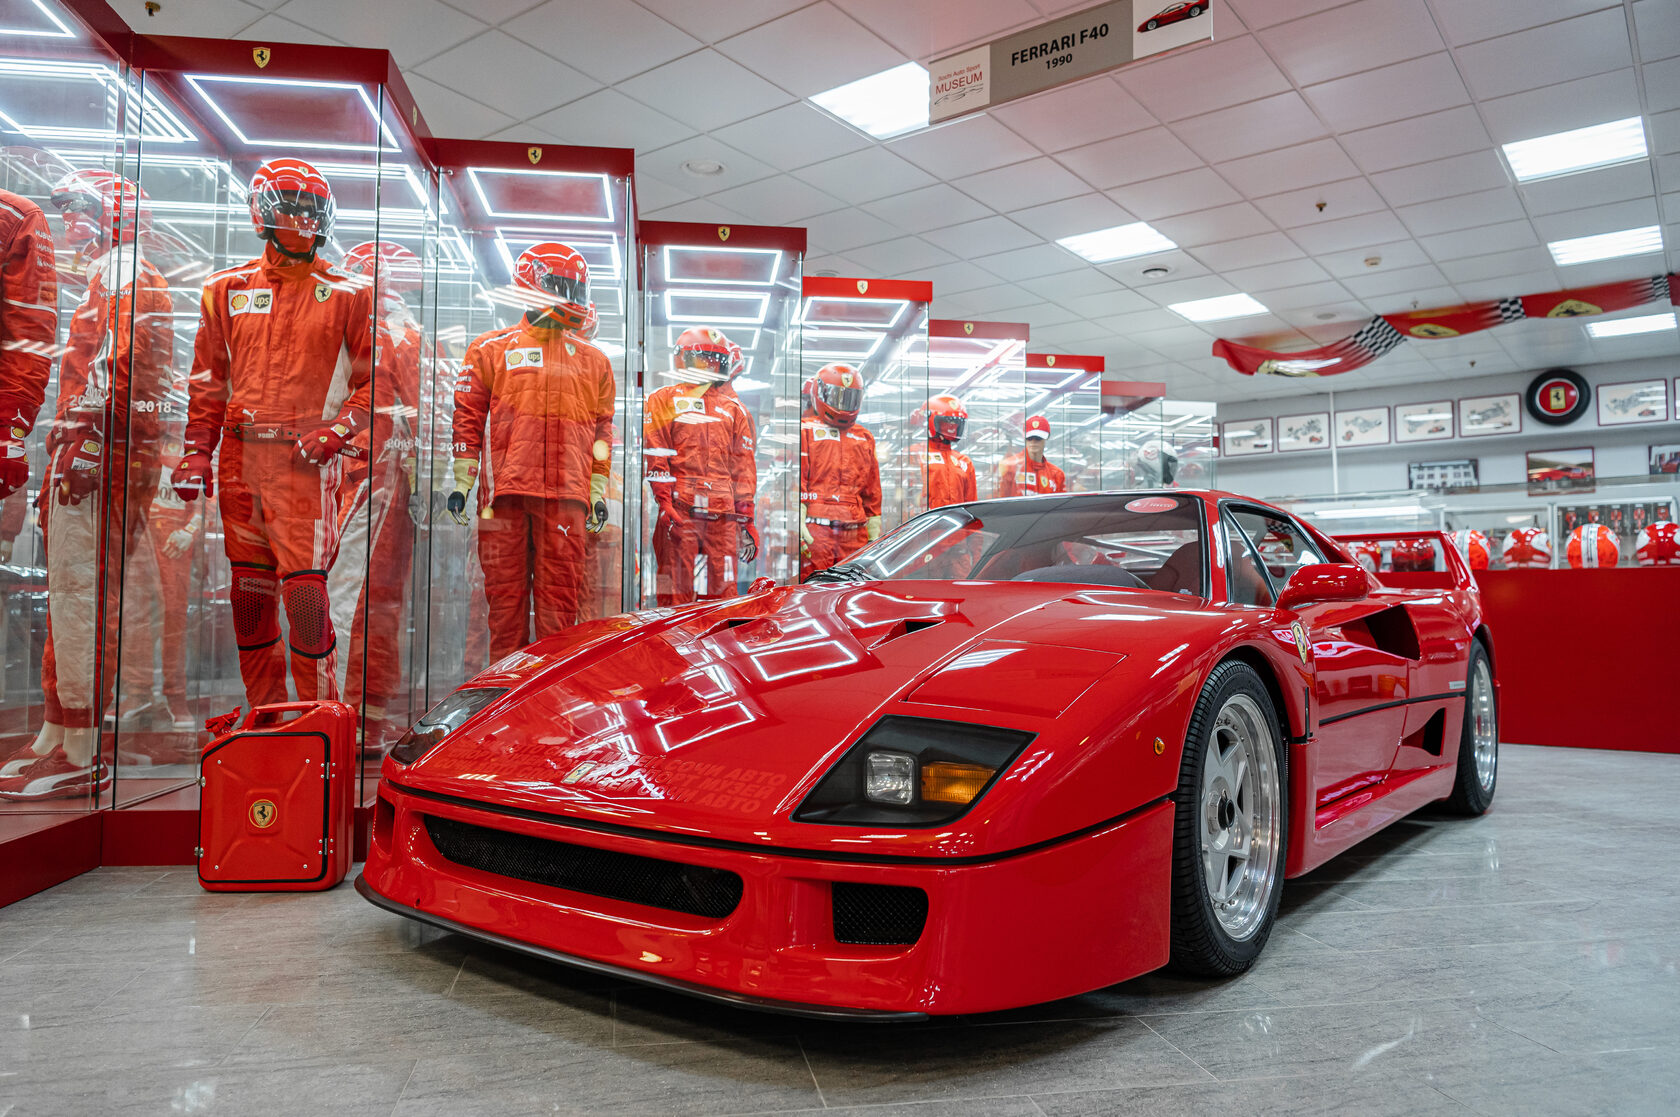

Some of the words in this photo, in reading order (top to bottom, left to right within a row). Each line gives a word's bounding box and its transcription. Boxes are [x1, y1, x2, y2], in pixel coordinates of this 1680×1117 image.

[1011, 33, 1076, 67] FERRARI
[1080, 23, 1109, 45] F40
[953, 69, 965, 77] Auto
[966, 63, 981, 73] Sport
[1046, 53, 1073, 70] 1990
[935, 70, 983, 95] MUSEUM
[255, 296, 270, 309] ups
[137, 400, 172, 413] 2018
[440, 442, 467, 452] 2018
[664, 760, 726, 777] СОЧИ
[724, 768, 787, 786] АВТО
[695, 793, 761, 813] АВТО
